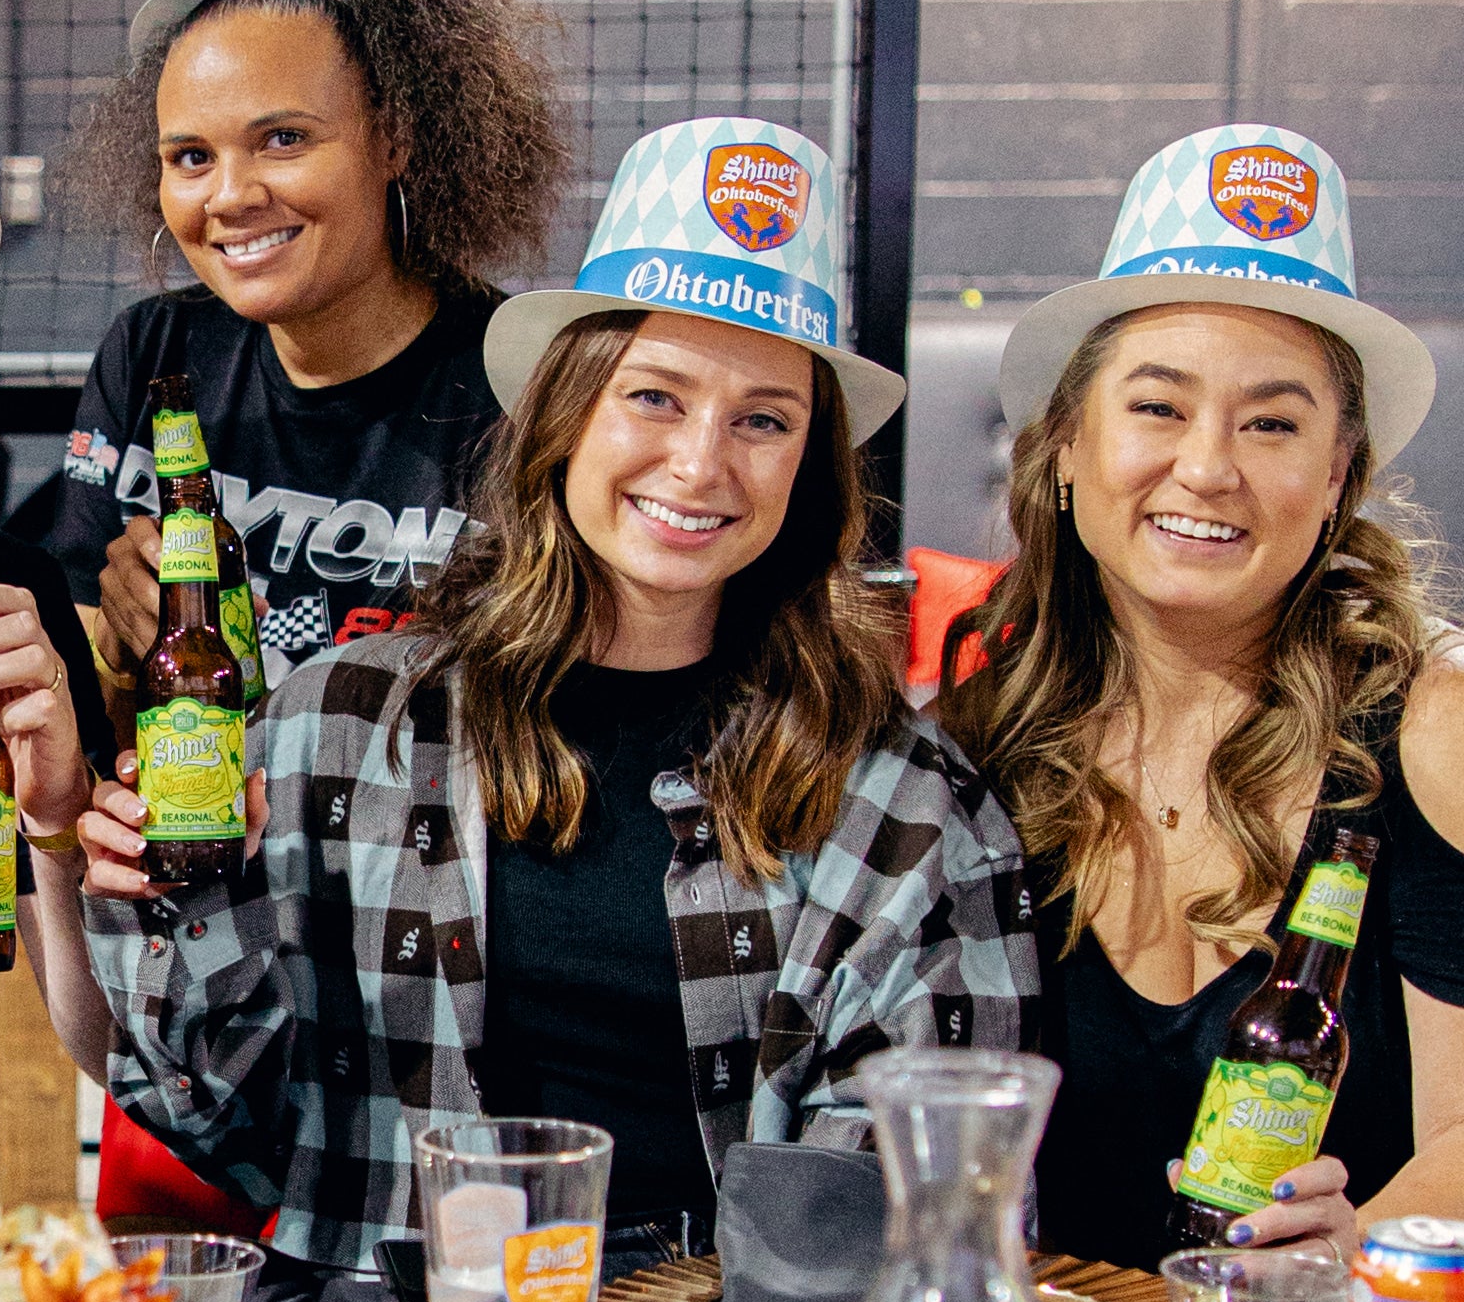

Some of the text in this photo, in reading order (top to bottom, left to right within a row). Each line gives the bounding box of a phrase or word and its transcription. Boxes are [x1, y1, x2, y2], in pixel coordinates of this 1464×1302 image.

[718, 154, 800, 184] Shiner
[1223, 156, 1307, 183] Shiner
[709, 186, 800, 226] Oktoberfest
[1216, 183, 1310, 218] Oktoberfest
[624, 256, 829, 345] Oktoberfest
[164, 528, 211, 555] Shiner
[162, 560, 212, 572] SEASONAL
[151, 731, 222, 768] Shiner
[161, 812, 216, 823] SEASONAL
[1300, 911, 1355, 937] SEASONAL
[1226, 1098, 1314, 1132] Shiner
